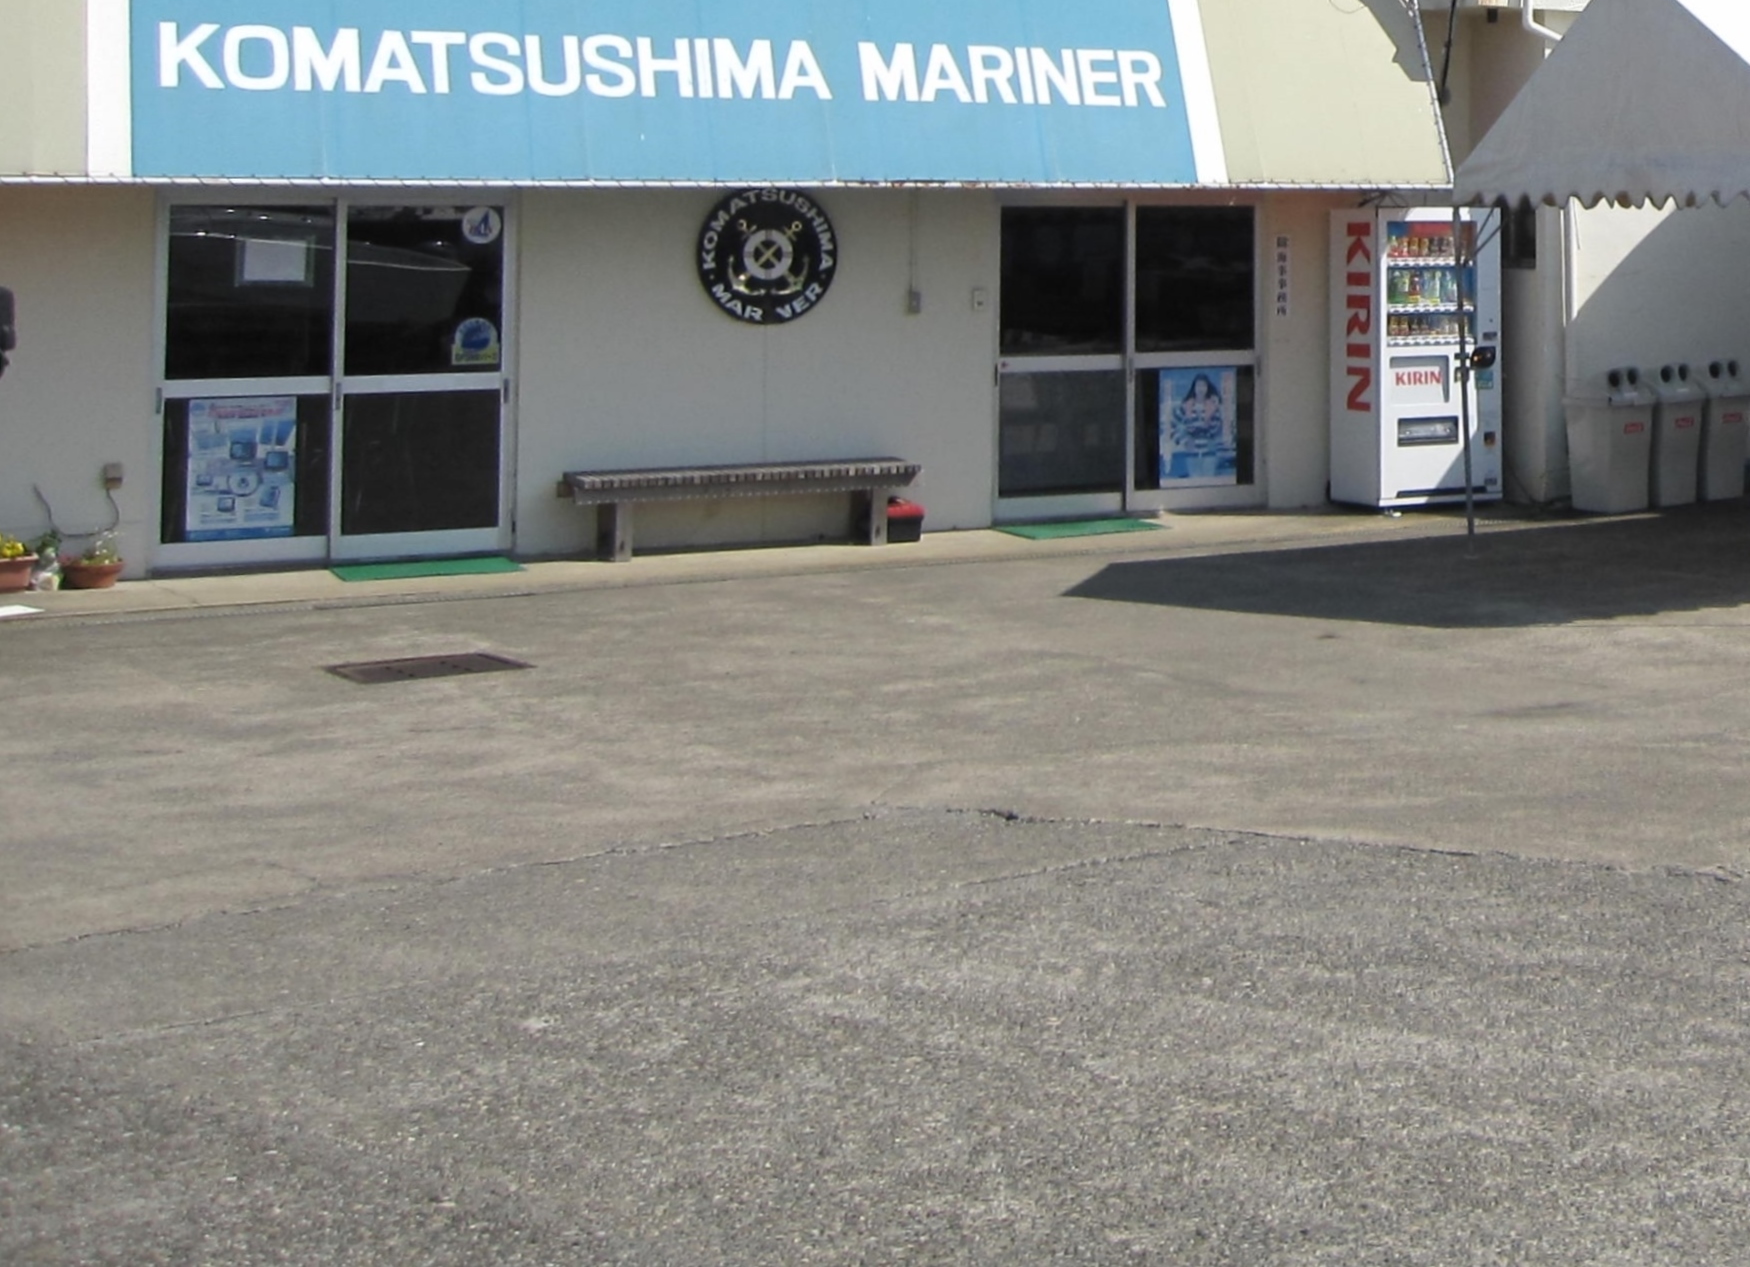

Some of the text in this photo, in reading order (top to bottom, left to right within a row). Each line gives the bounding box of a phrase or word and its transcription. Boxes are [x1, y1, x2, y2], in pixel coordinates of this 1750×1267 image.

[157, 20, 1167, 109] KOMATSUSHIMA MARINER
[702, 189, 834, 271] KOMATSUSHIMA
[1346, 221, 1371, 413] KIRIN
[1394, 369, 1443, 387] KIRIN
